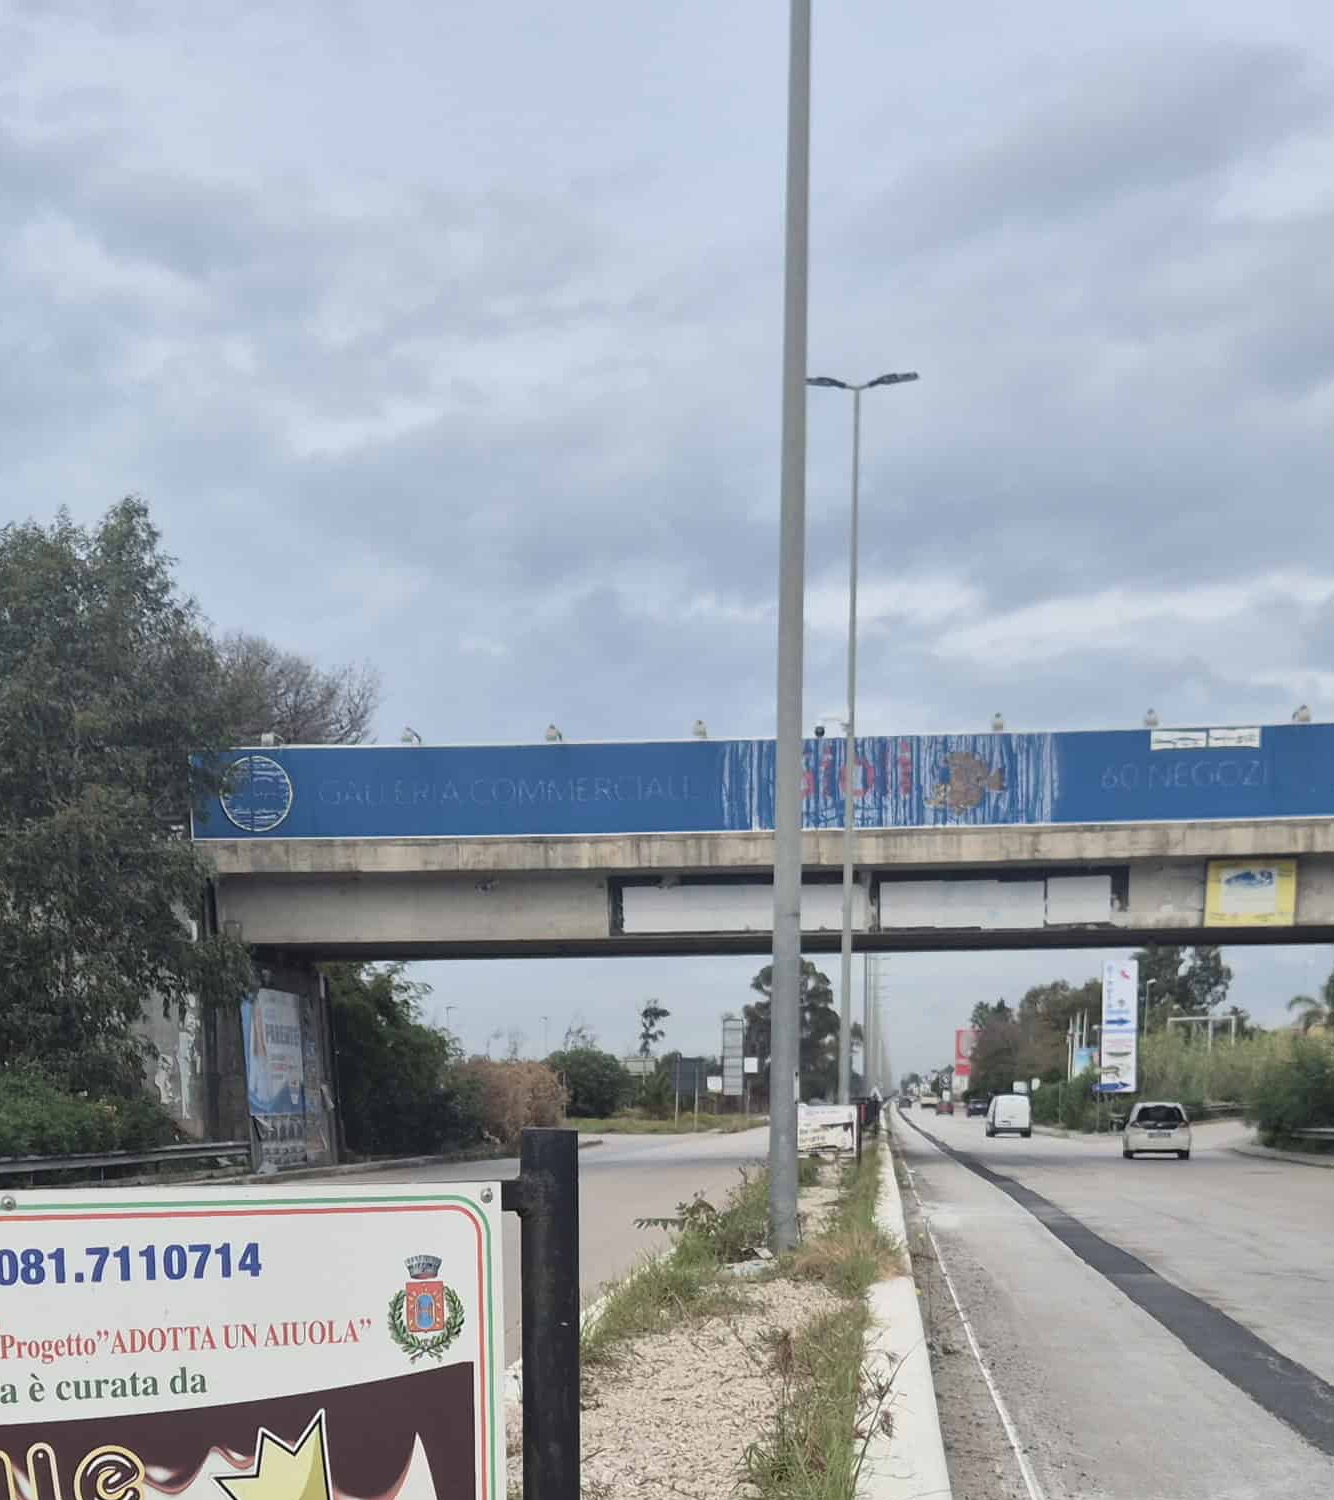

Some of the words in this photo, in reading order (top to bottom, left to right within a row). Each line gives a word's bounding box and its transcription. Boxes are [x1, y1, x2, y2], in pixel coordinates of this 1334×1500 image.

[1147, 758, 1268, 791] NEGOZI
[223, 1323, 258, 1350] UN
[28, 1373, 45, 1402] è
[55, 1370, 159, 1402] curata
[169, 1366, 208, 1395] da
